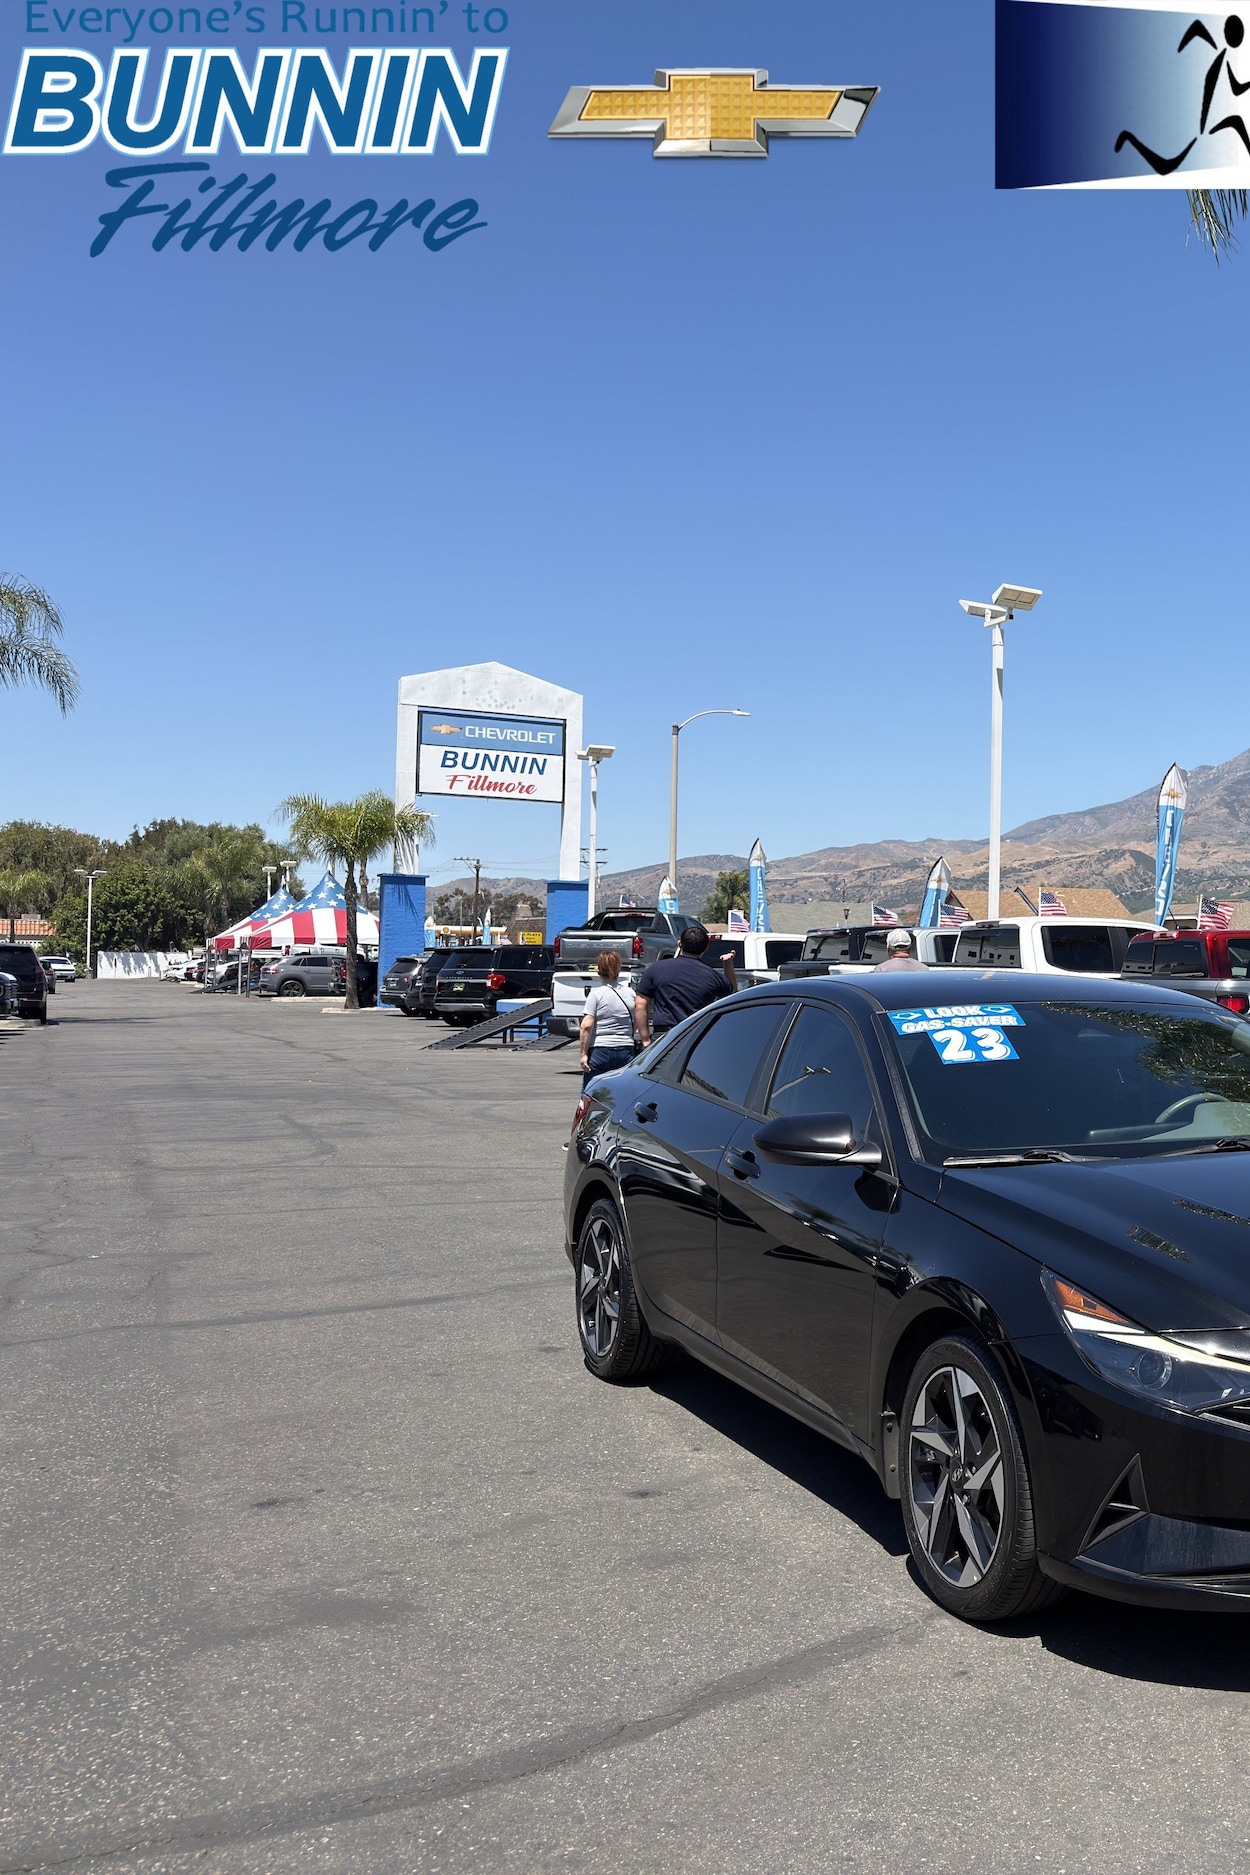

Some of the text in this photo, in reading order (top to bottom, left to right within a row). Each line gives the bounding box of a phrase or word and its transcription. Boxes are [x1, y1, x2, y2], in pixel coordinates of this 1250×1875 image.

[465, 725, 556, 745] CHEVROLET
[440, 750, 548, 776] BUNNIN
[446, 774, 538, 795] Fillmore
[924, 1005, 988, 1020] LOOK
[901, 1015, 1019, 1033] GAS-SAVER
[932, 1027, 1012, 1062] 23
